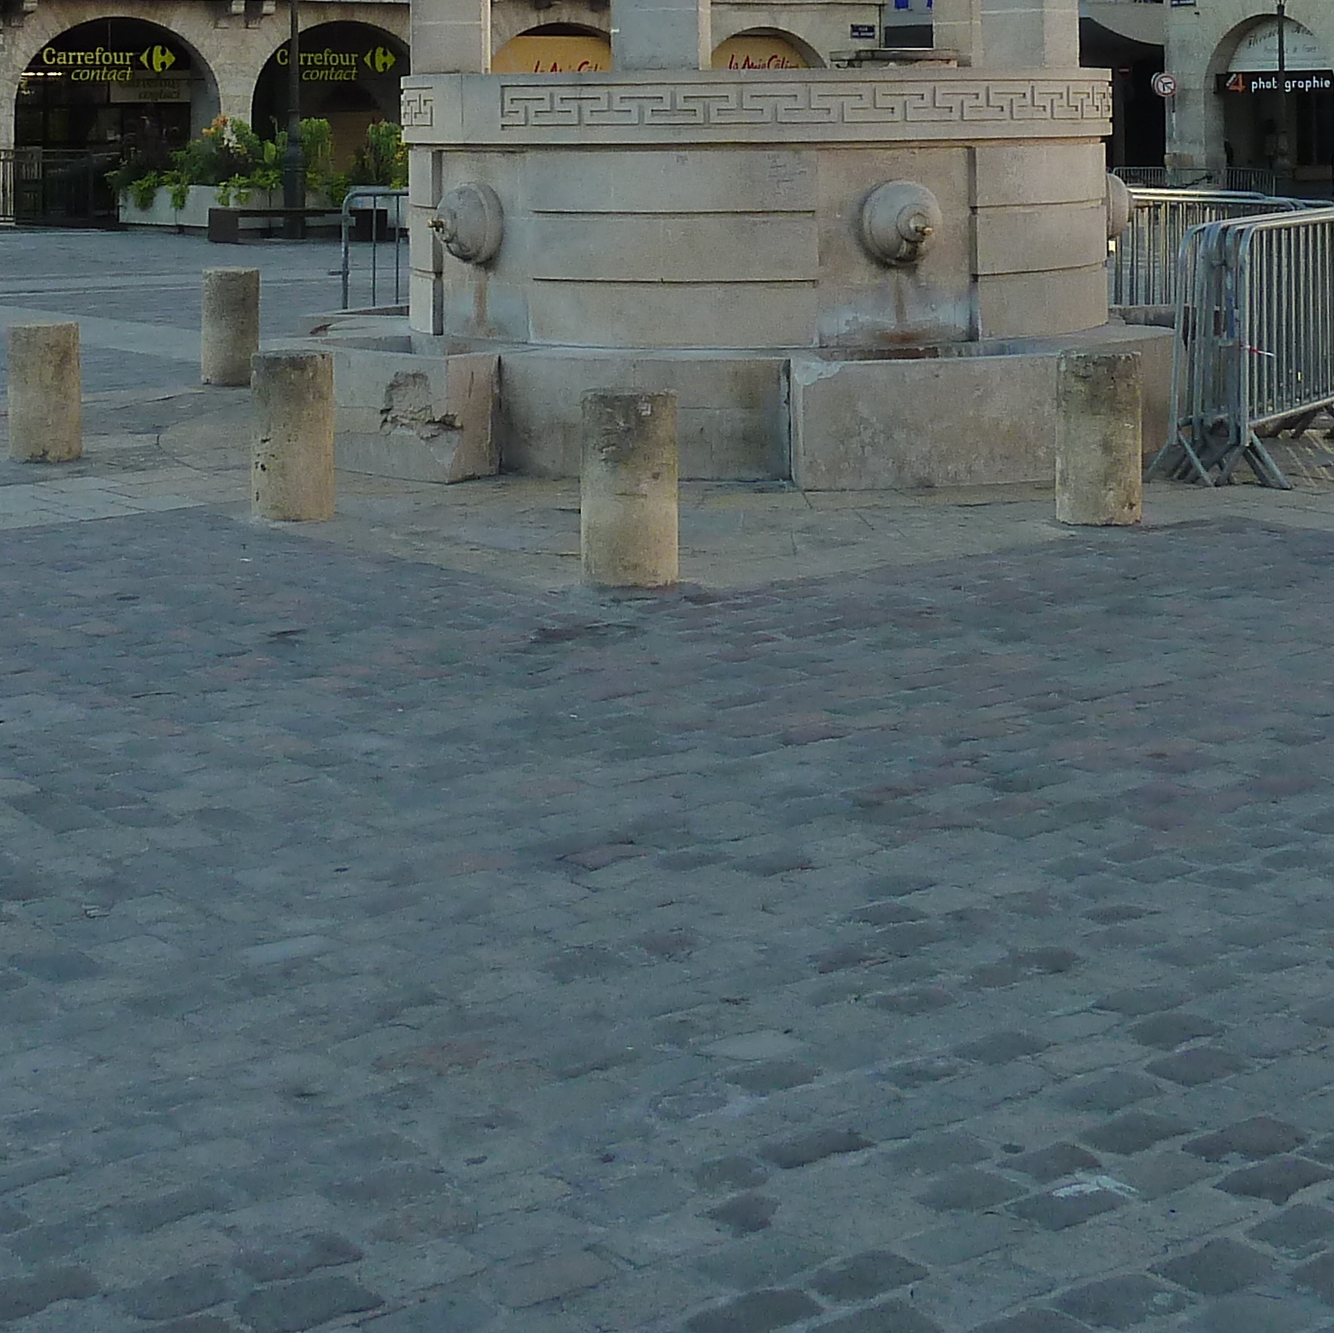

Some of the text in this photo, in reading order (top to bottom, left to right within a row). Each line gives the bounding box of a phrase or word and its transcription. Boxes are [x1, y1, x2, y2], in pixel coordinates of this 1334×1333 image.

[42, 47, 134, 65] Carrefour
[276, 48, 359, 66] Crrefour
[71, 66, 134, 82] contact
[301, 67, 359, 81] contact
[1251, 76, 1331, 94] photgraphie
